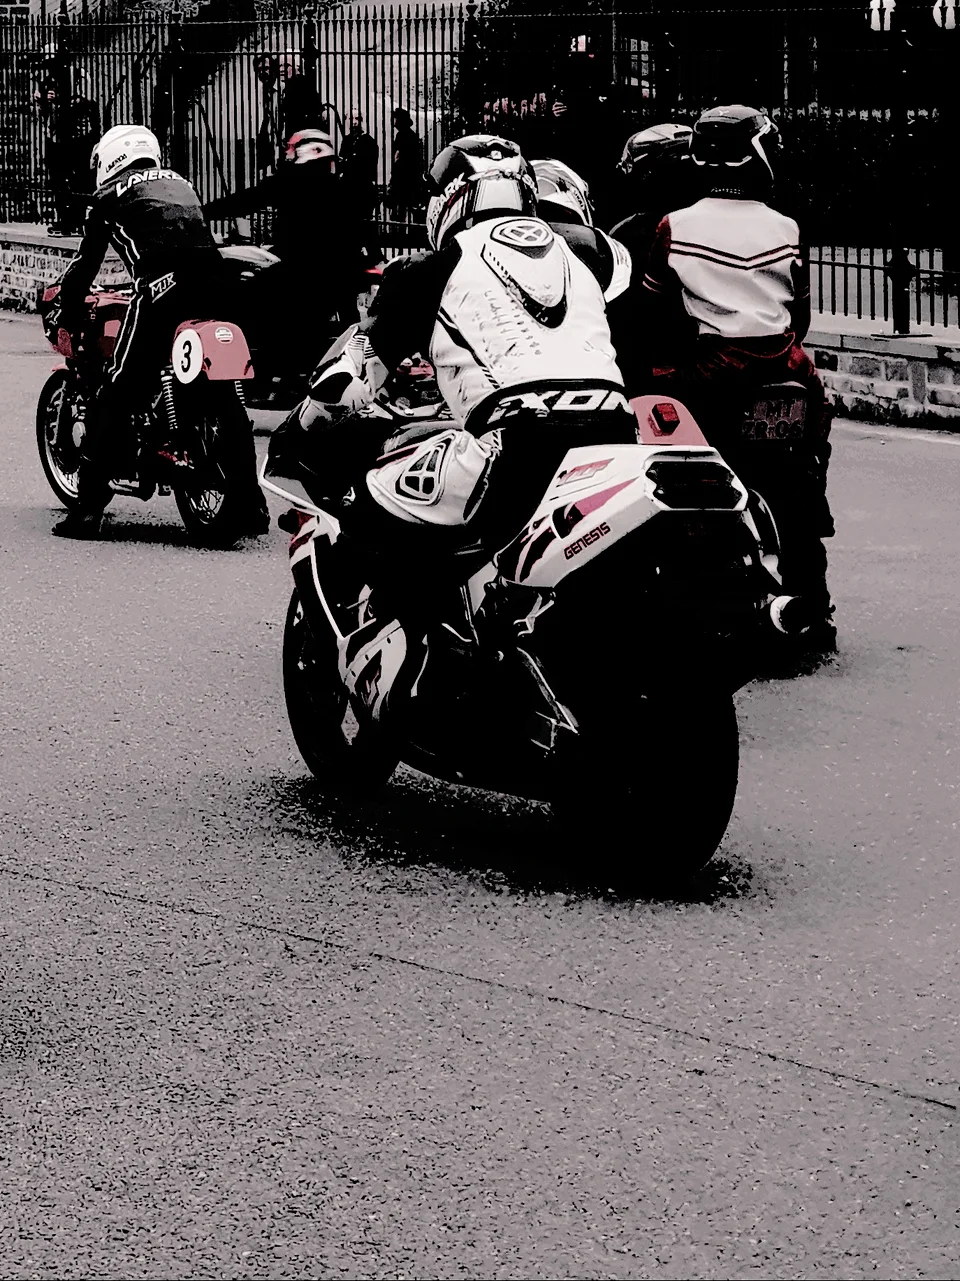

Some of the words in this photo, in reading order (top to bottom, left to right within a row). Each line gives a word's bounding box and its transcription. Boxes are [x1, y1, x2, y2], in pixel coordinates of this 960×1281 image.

[116, 169, 193, 198] LAVER
[181, 340, 192, 373] 3
[563, 521, 612, 560] GENESIS
